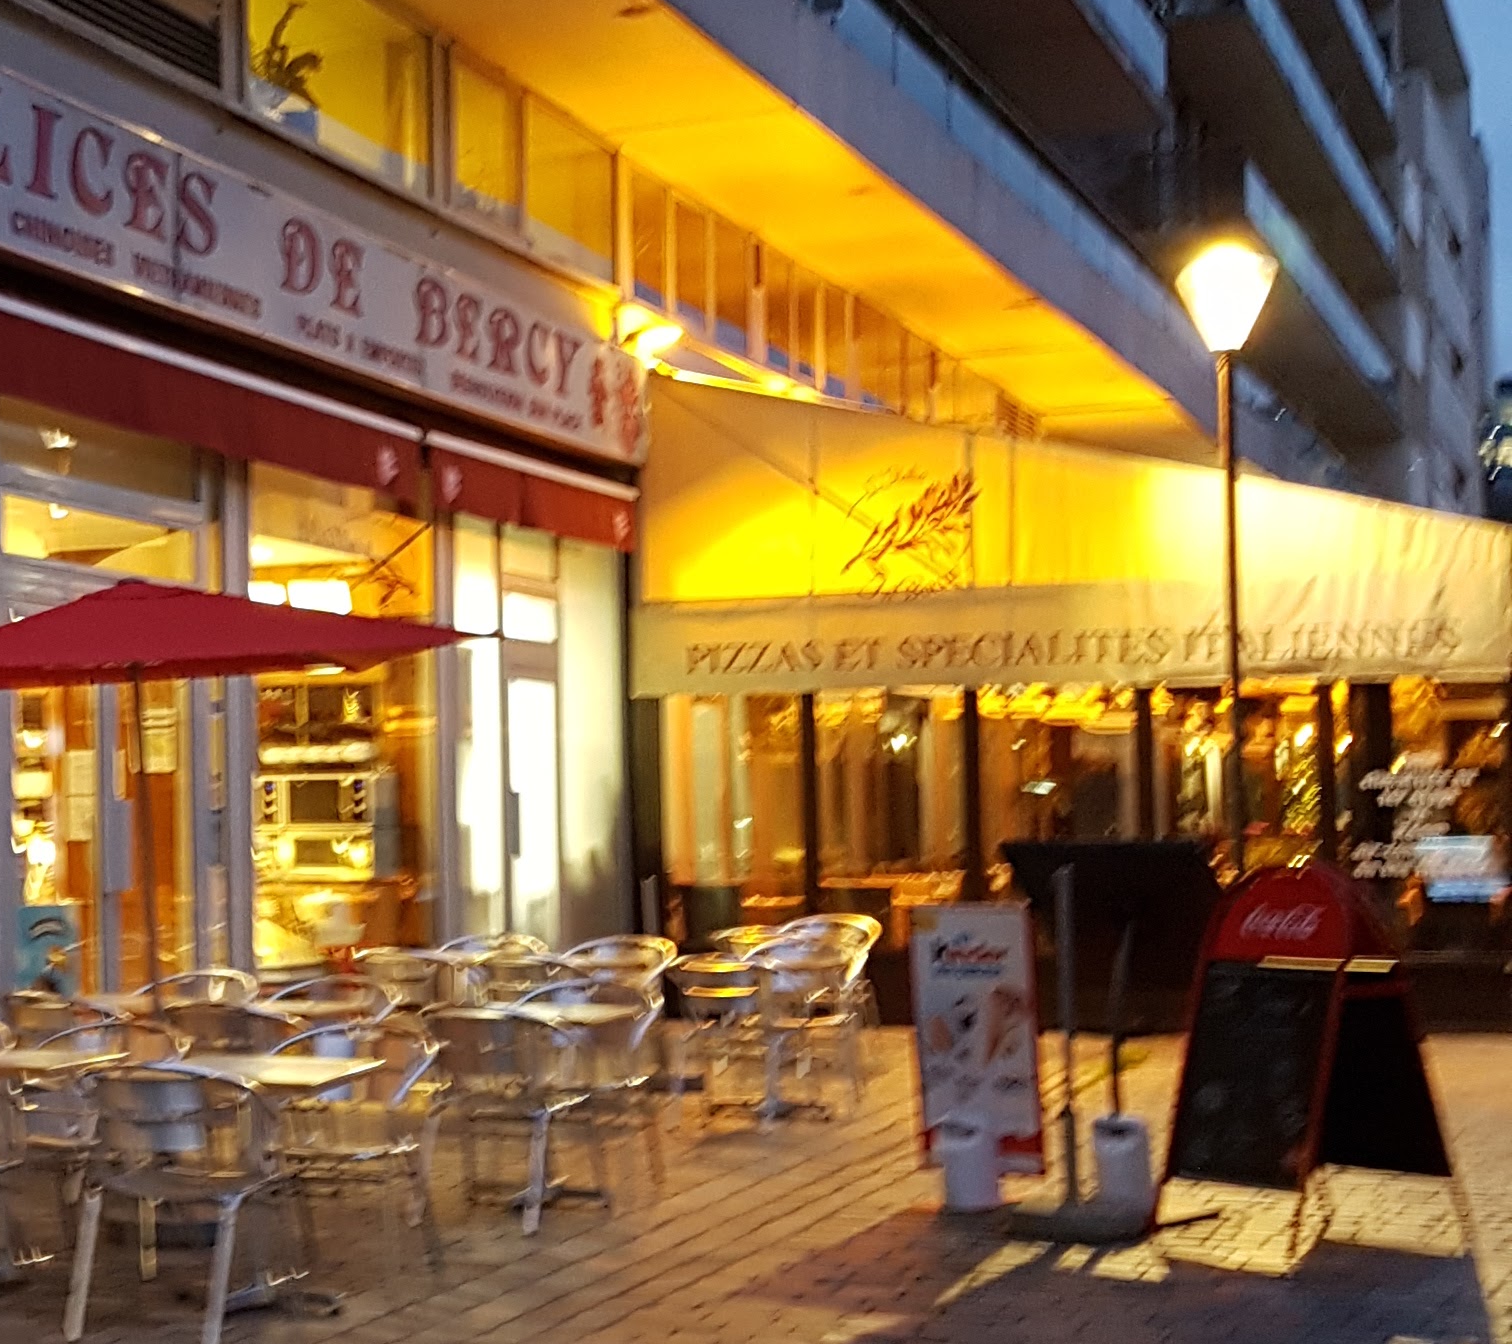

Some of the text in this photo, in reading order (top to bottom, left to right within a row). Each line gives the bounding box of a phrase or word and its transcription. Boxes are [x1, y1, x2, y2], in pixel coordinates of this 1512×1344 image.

[280, 217, 366, 318] DE
[414, 277, 584, 397] BERCY
[686, 617, 1464, 676] PIZZAS ET SPECIALITES ITALIENNES
